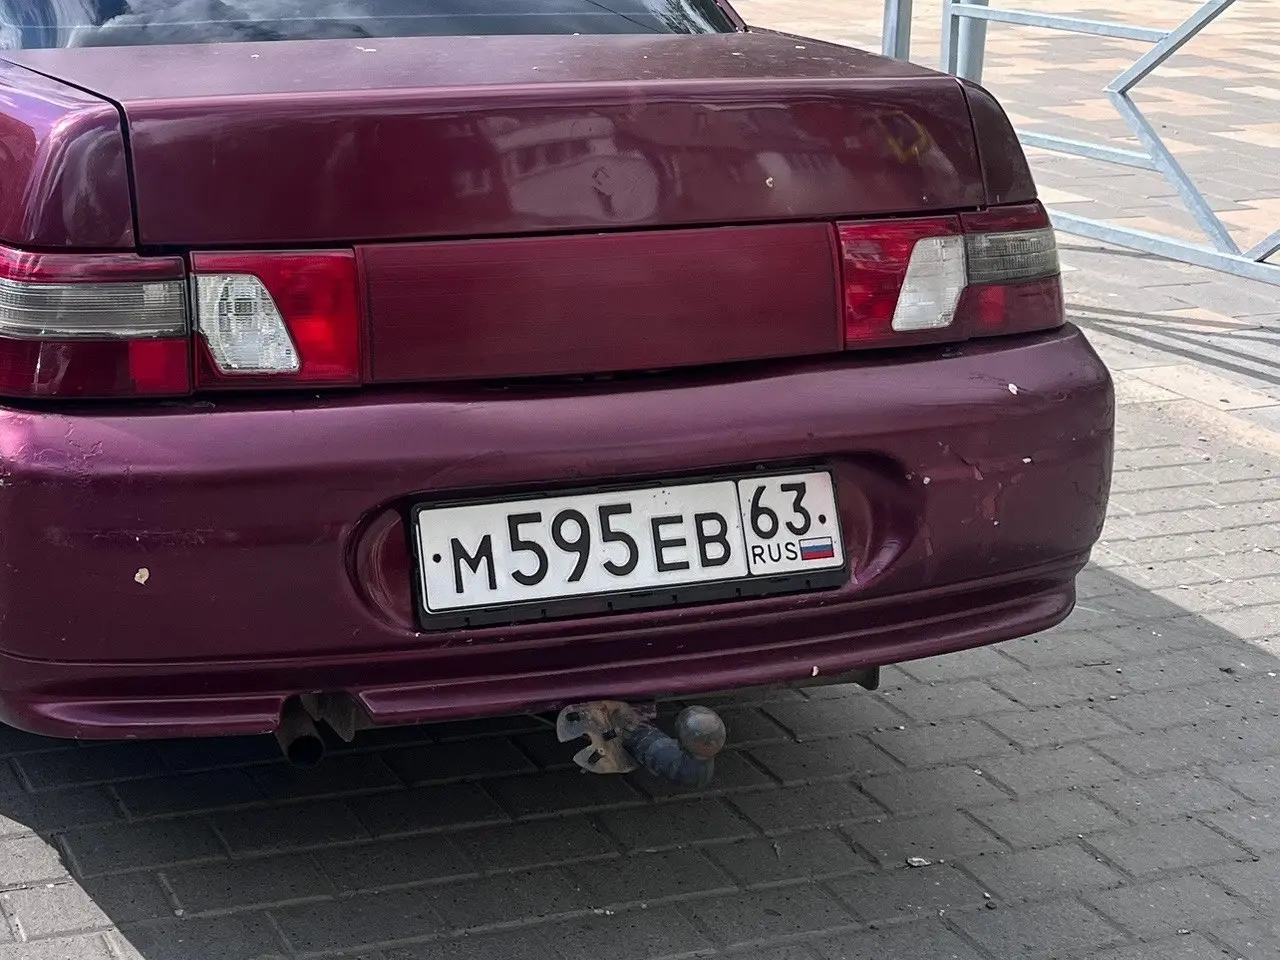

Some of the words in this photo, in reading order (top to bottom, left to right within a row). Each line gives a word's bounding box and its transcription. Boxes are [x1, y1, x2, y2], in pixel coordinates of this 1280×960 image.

[450, 503, 732, 594] М595ЕВ
[749, 481, 812, 540] 63
[751, 541, 799, 565] RUS
